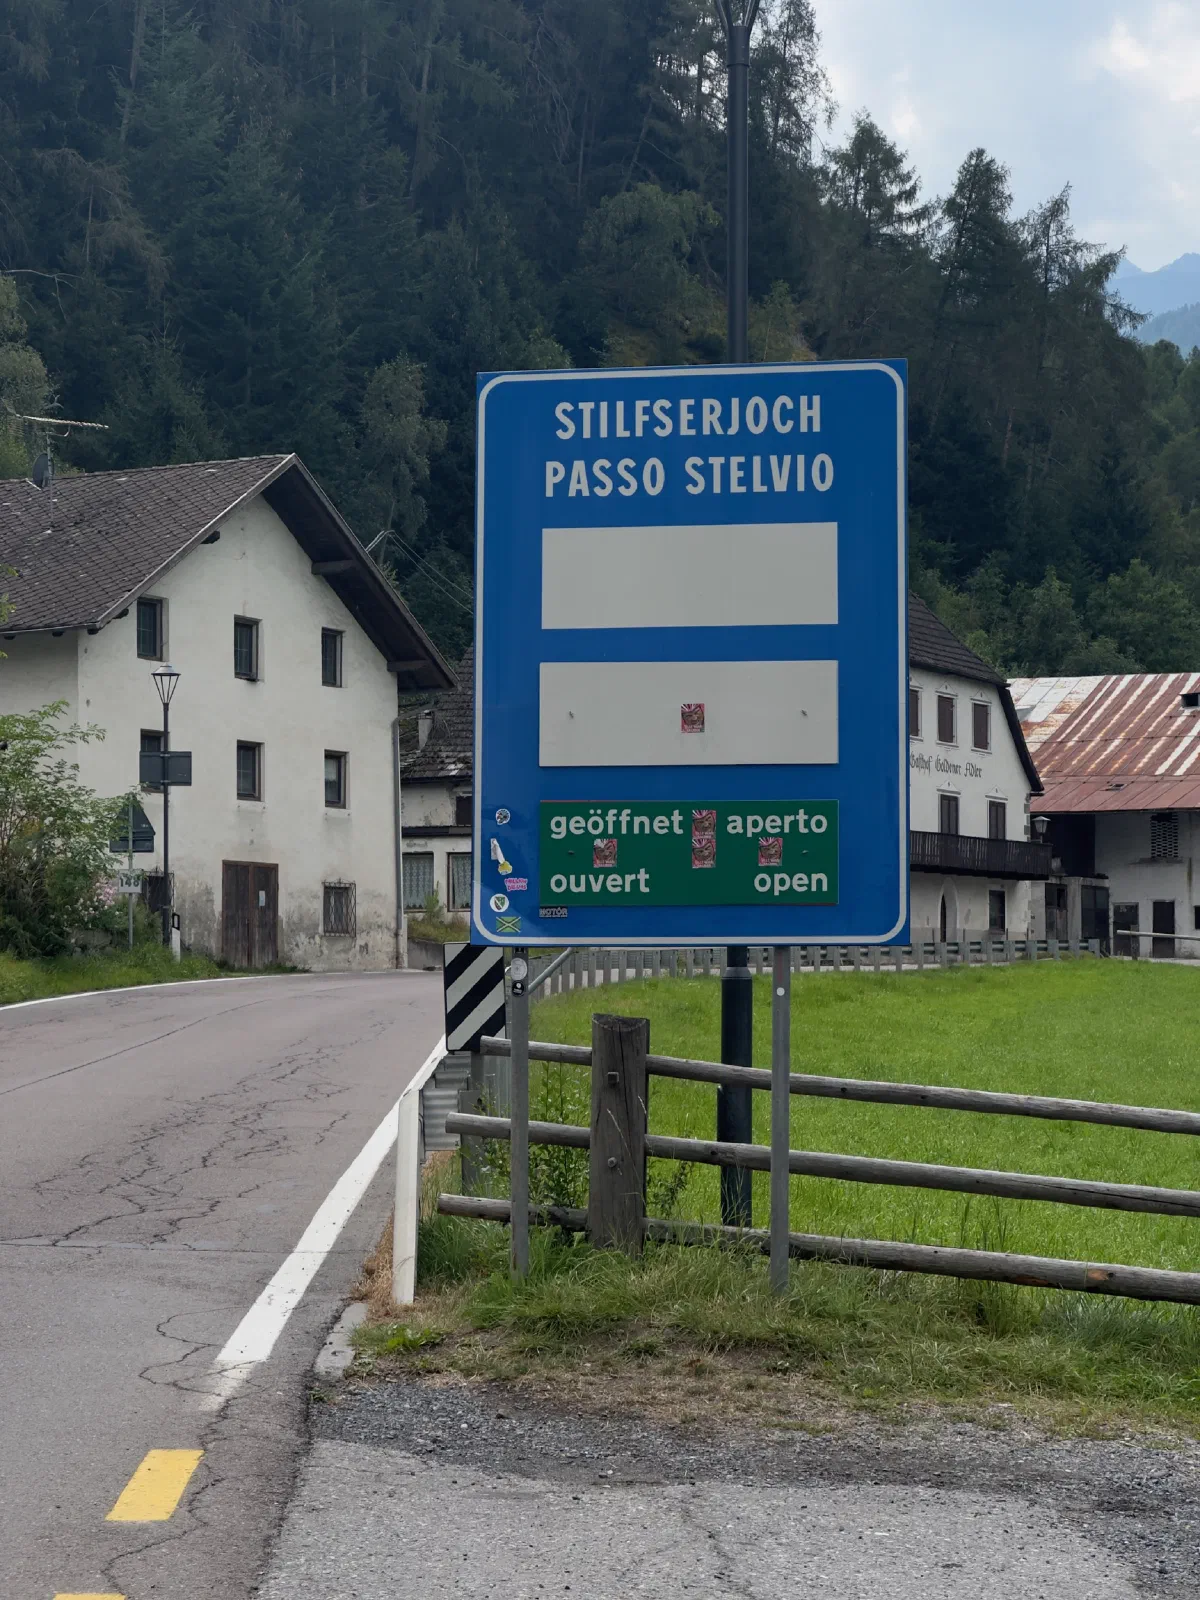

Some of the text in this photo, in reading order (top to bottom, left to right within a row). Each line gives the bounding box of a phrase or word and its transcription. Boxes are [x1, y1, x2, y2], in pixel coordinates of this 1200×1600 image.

[555, 395, 820, 440] STILFSERJOCH
[545, 453, 834, 497] PASSO STELVIO
[964, 762, 982, 778] Adler
[550, 809, 828, 839] geöffnet aperto
[550, 868, 650, 893] ouvert
[754, 872, 828, 896] open
